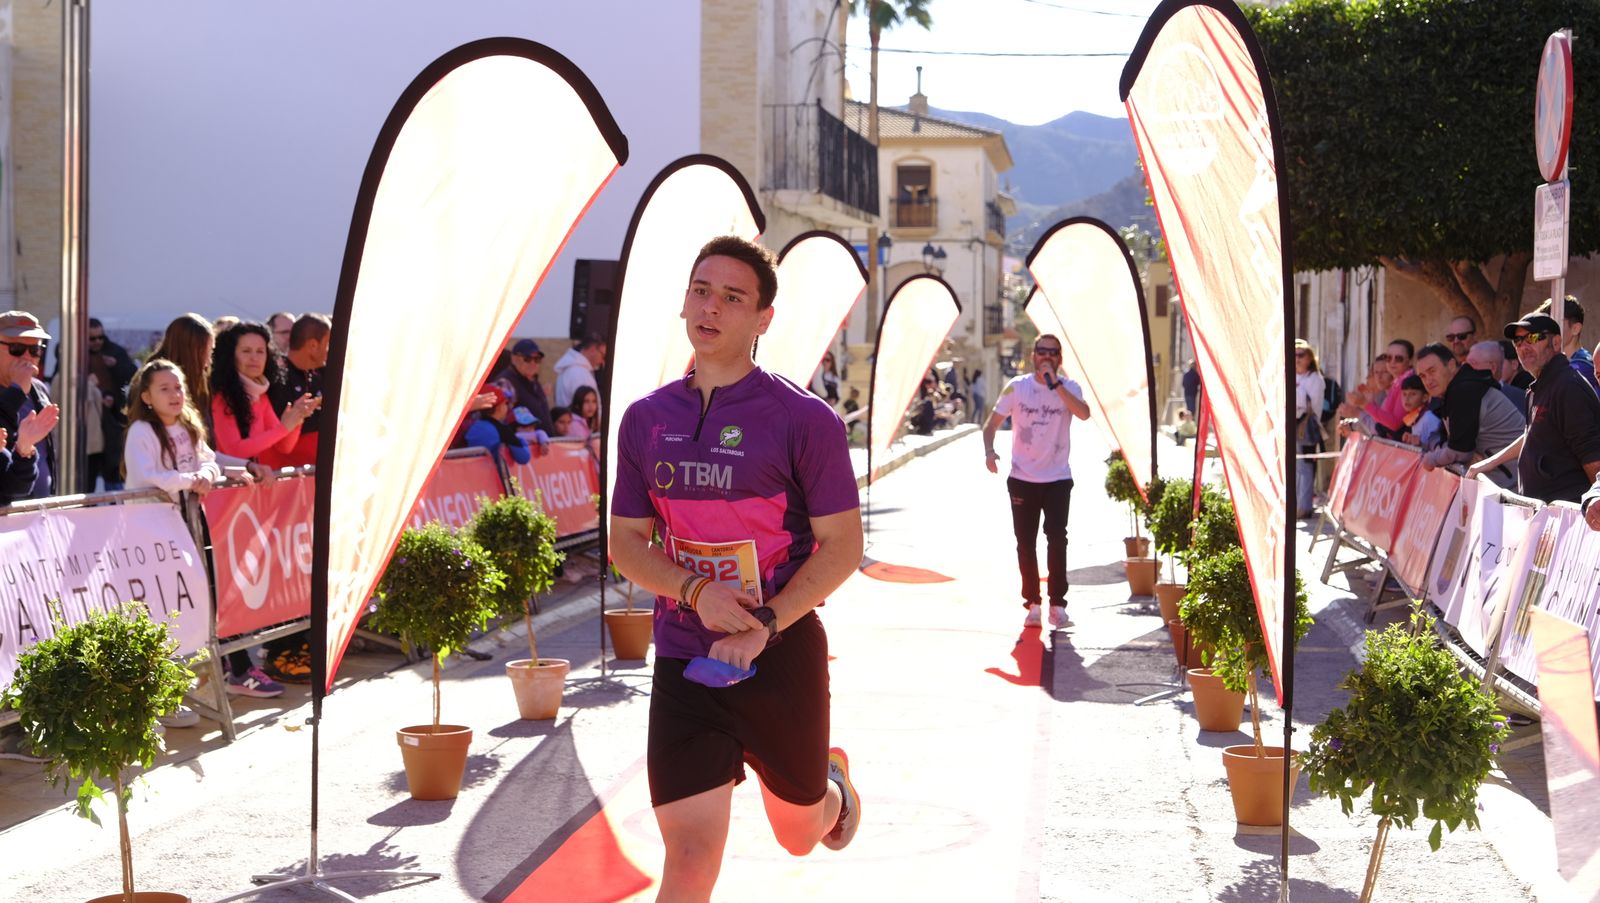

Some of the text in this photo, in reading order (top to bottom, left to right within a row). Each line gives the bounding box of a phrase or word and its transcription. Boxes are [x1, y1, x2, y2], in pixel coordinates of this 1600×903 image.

[539, 468, 591, 512] VEOLIA
[679, 461, 733, 490] TBM
[154, 540, 181, 563] DE
[0, 570, 194, 650] ANTORIA
